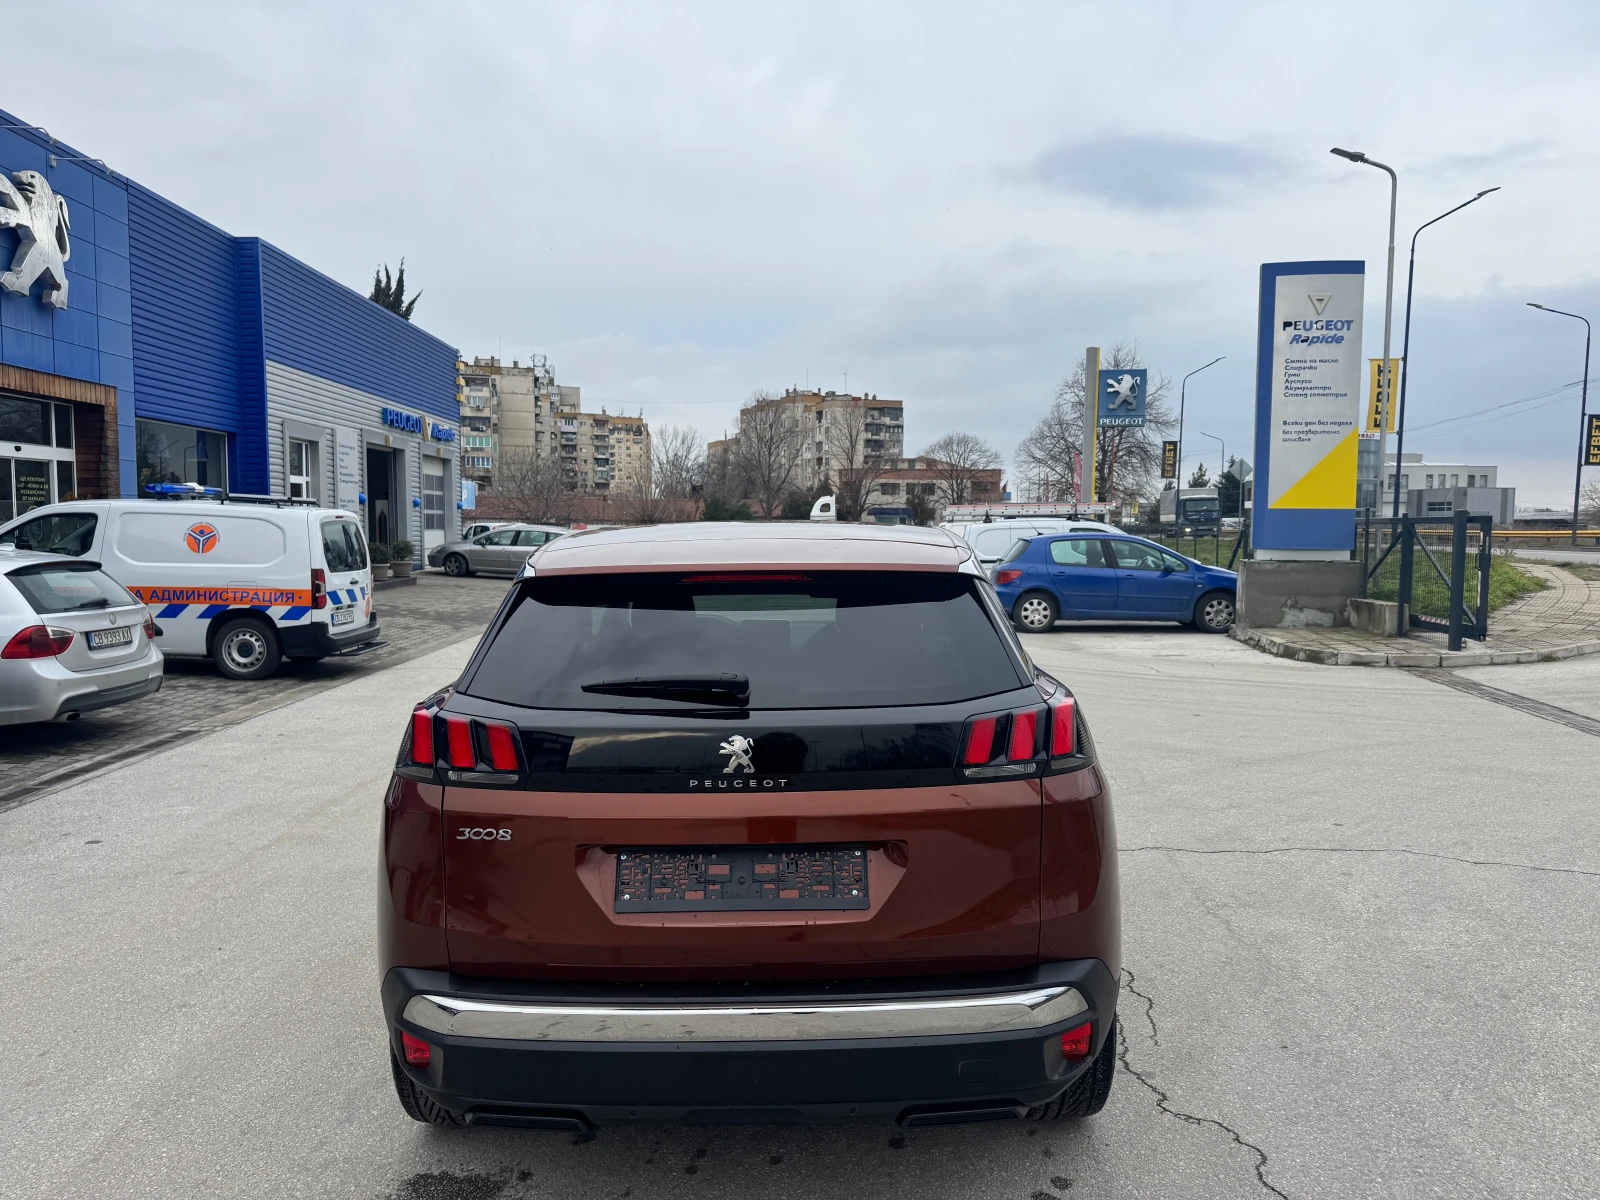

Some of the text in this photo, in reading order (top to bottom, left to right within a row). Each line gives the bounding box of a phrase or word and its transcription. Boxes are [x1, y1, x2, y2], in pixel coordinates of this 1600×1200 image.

[1282, 319, 1354, 331] PEUGEOT
[1289, 333, 1345, 346] Rapide
[1099, 417, 1144, 426] PEUGEOT
[150, 589, 295, 604] АДМИНИСТРАЦИЯ
[93, 628, 130, 645] CB 9393 AX
[689, 778, 789, 788] PEUGEOT
[455, 827, 513, 842] 3008
